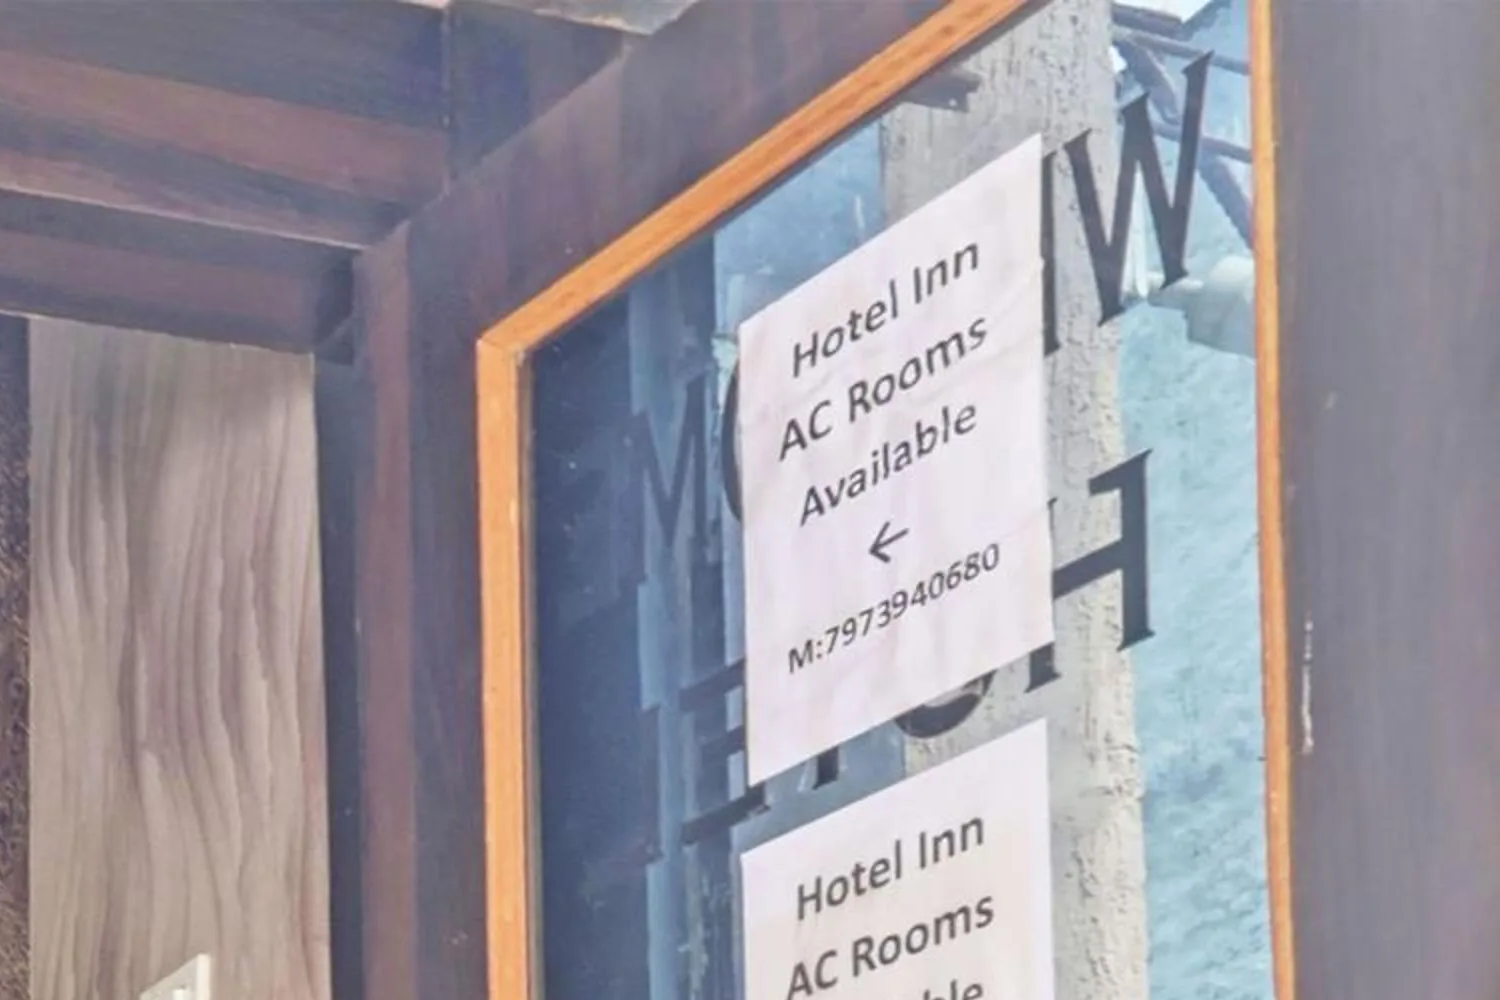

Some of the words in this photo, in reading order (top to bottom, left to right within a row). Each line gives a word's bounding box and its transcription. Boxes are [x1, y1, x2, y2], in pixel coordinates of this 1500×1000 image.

[791, 280, 898, 379] Hotel
[912, 240, 981, 303] Inn
[778, 400, 833, 461] AC
[847, 314, 989, 426] Rooms
[799, 404, 978, 528] Available
[787, 542, 1001, 675] M:7973940680
[796, 840, 902, 921] Hotel
[917, 815, 985, 870] Inn
[851, 896, 996, 980] Rooms
